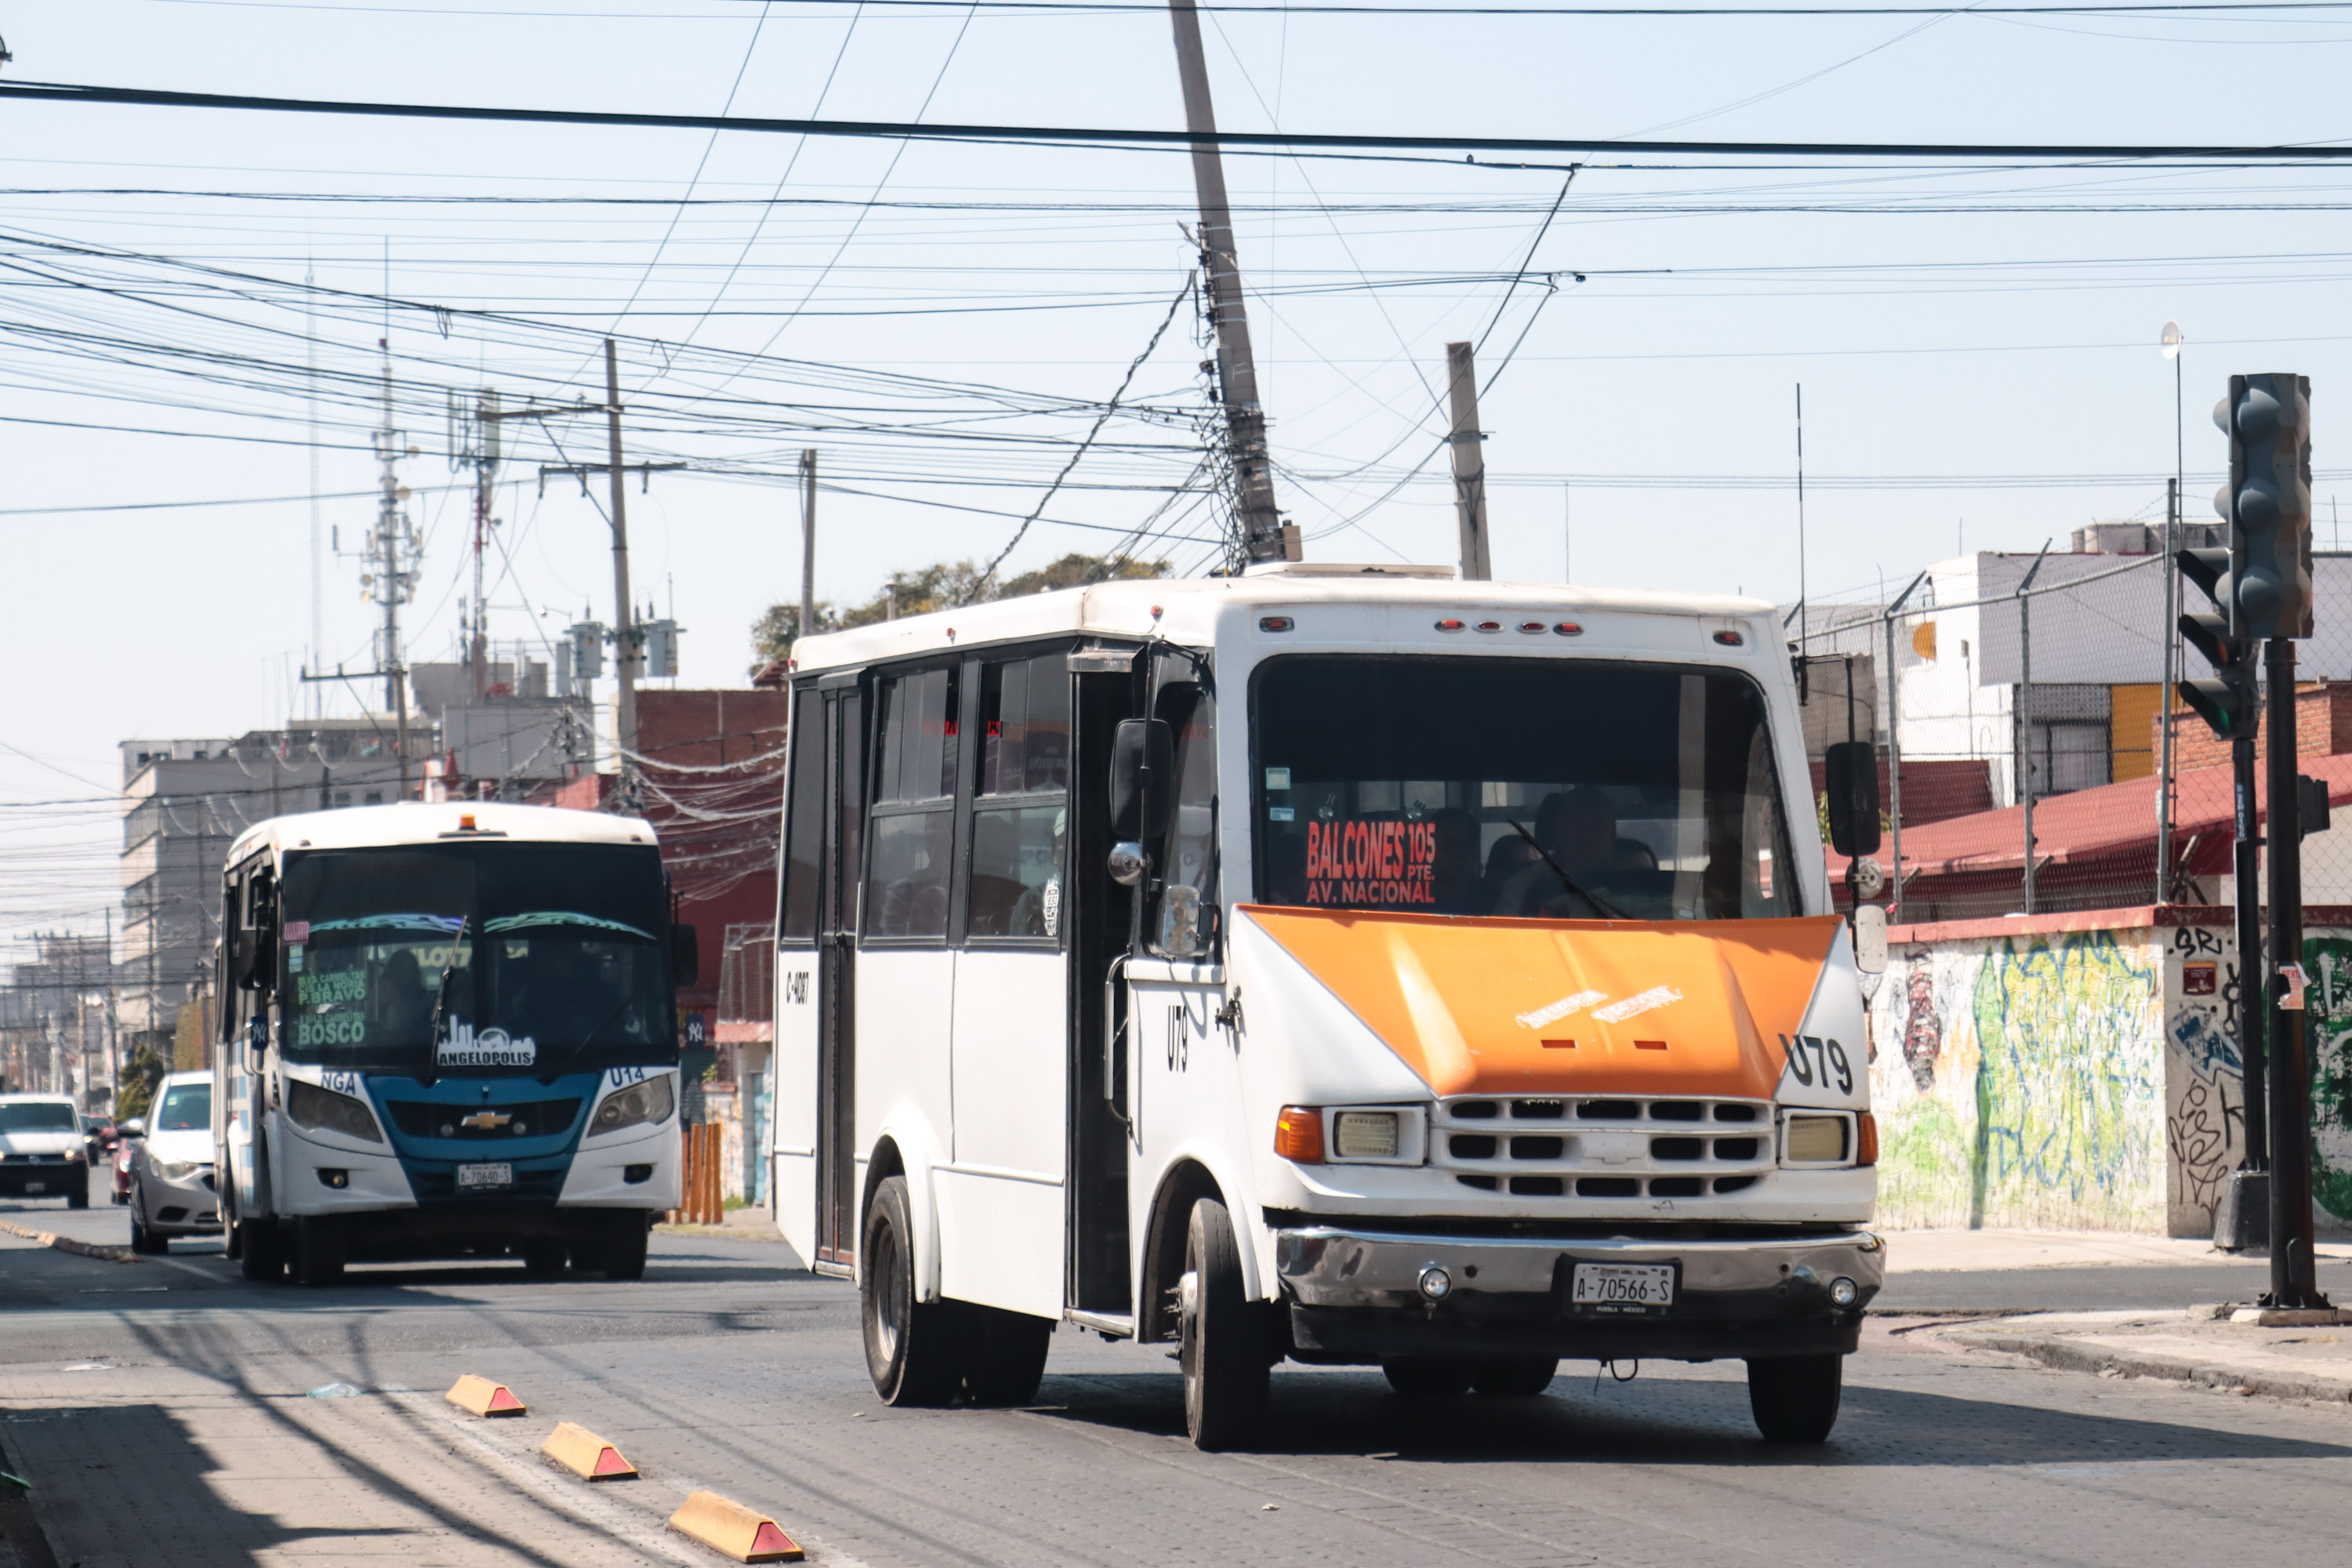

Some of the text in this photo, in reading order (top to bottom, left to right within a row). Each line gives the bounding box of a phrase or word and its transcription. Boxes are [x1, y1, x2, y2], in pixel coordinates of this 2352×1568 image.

[1307, 821, 1436, 880] BALCONES 105
[1407, 865, 1435, 880] PTE.
[1307, 881, 1436, 903] AV. NACIONAL
[298, 1021, 365, 1046] BOSCO
[1167, 1005, 1188, 1073] U79
[440, 1052, 532, 1065] ANGELOPOLIS
[1777, 1033, 1853, 1097] U79
[609, 1066, 644, 1087] U14
[1577, 1278, 1669, 1301] A-70566-S
